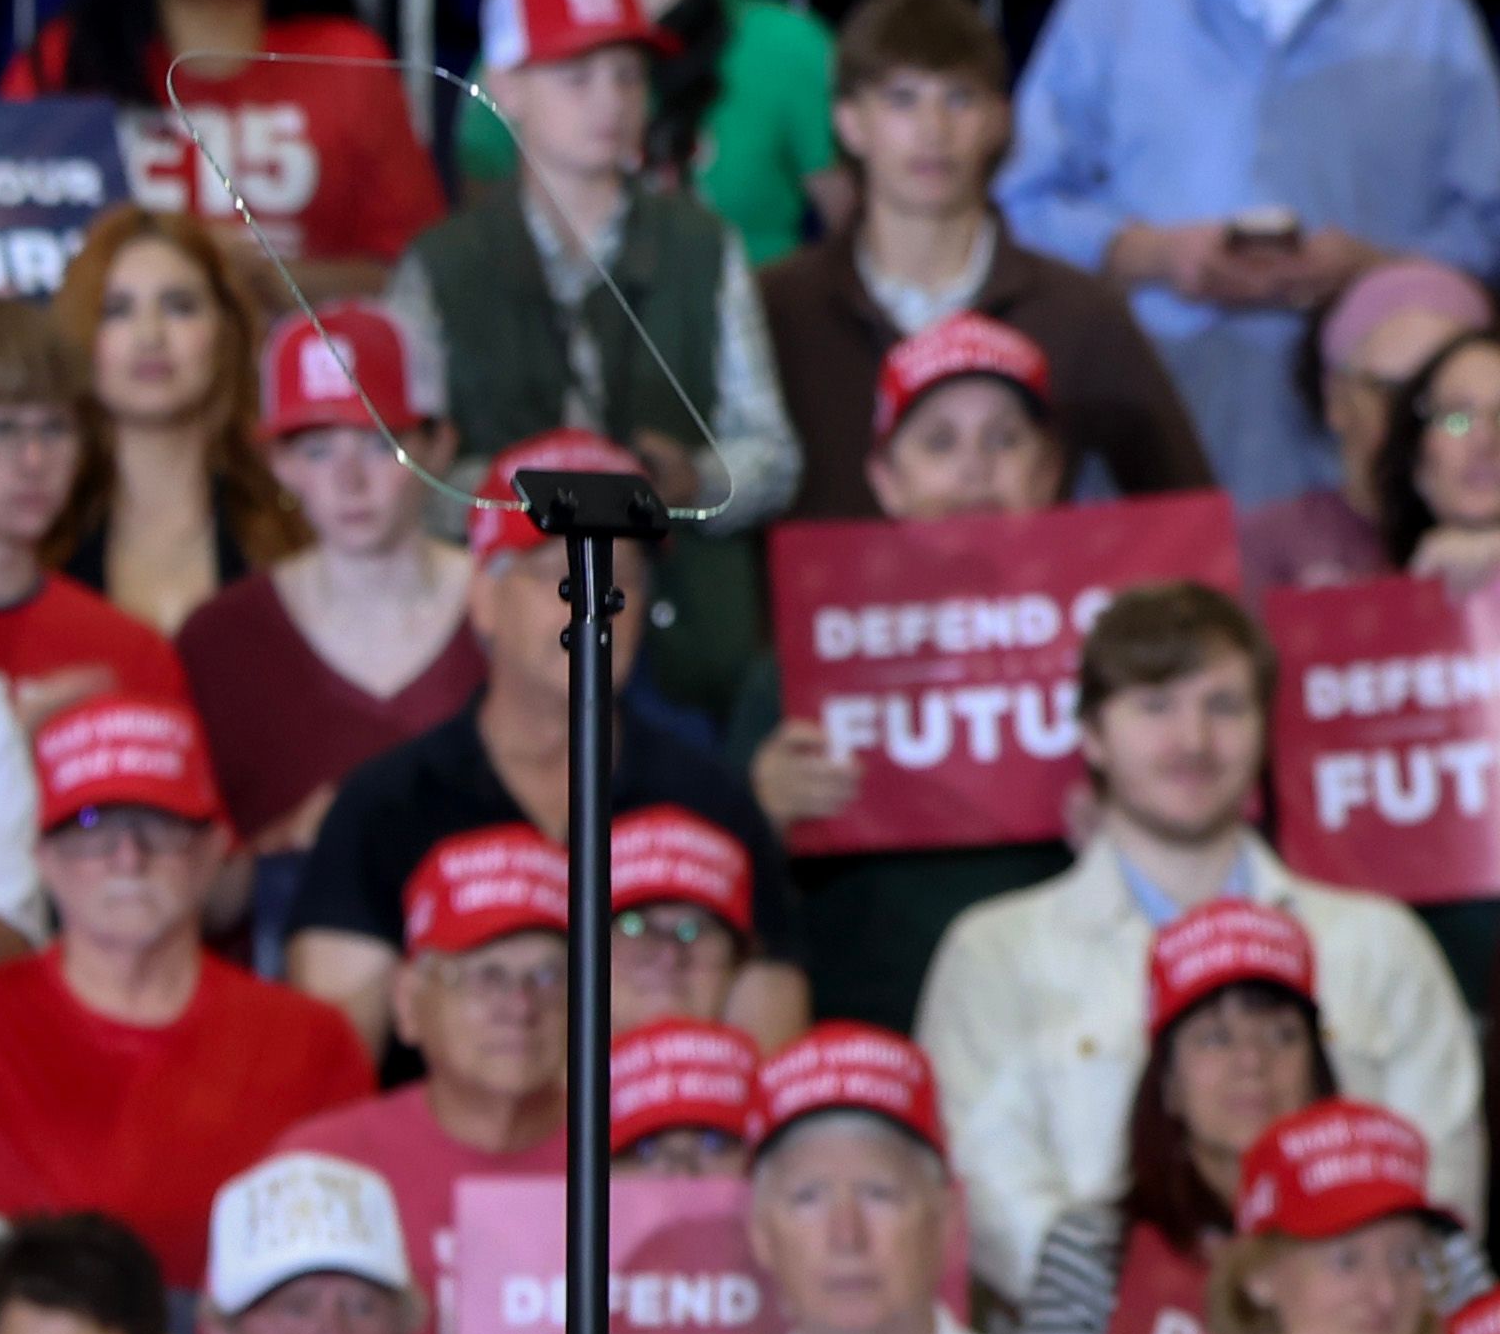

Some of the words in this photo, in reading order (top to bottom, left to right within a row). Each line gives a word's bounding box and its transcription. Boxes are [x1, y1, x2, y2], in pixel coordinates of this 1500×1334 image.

[813, 593, 1060, 661] DEFEND
[1305, 652, 1498, 721] DEFEN
[821, 684, 1081, 770] FUTU
